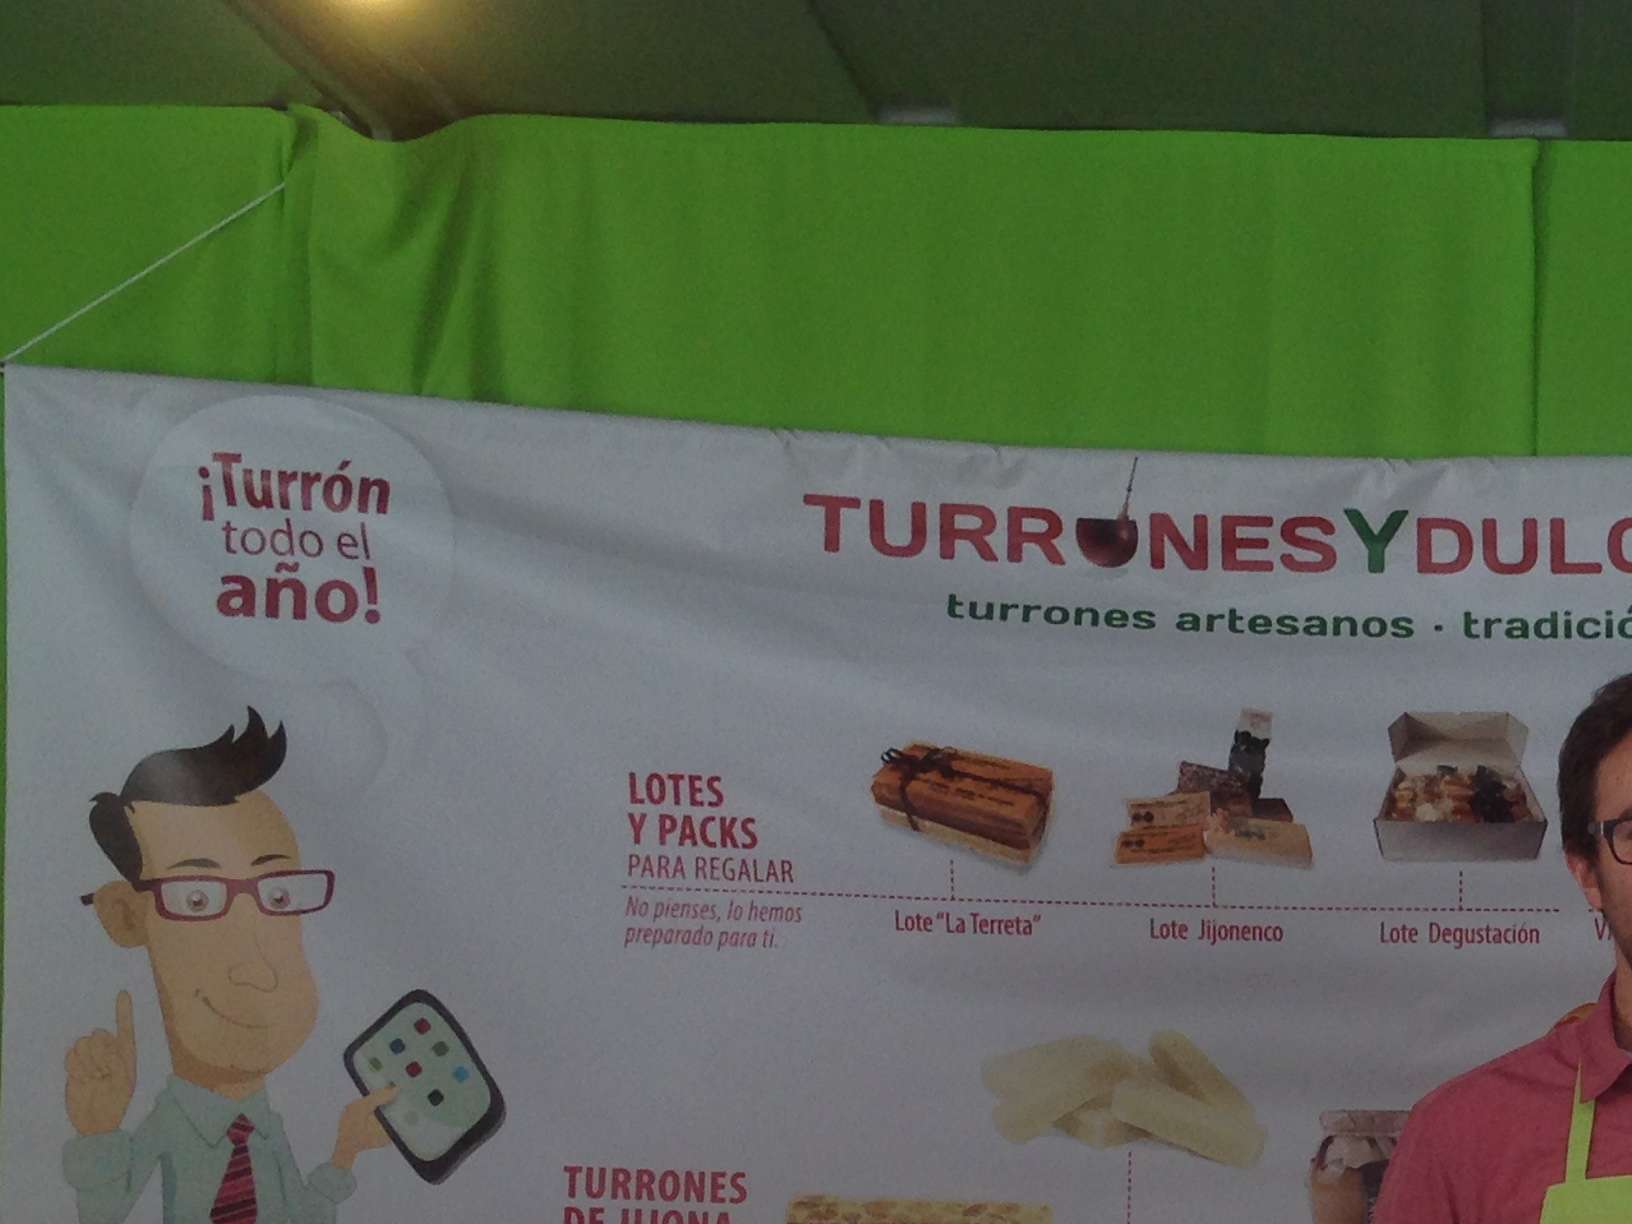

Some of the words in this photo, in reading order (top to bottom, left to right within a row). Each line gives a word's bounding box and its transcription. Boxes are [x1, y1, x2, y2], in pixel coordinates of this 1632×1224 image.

[198, 452, 391, 521] ¡Turrón
[222, 520, 323, 560] todo
[336, 522, 371, 560] el
[215, 562, 381, 625] año!
[947, 594, 1156, 630] turrones
[1175, 606, 1415, 638] artesanos
[628, 772, 724, 807] LOTES
[627, 812, 647, 845] Y
[658, 814, 758, 850] PACKS
[628, 854, 686, 880] PARA
[695, 857, 794, 883] REGALAR
[625, 897, 649, 917] No
[653, 900, 721, 924] pienses,
[727, 901, 743, 921] lo
[749, 901, 803, 923] hemos
[895, 910, 933, 933] Lote
[624, 925, 713, 949] preparado
[717, 930, 757, 951] para
[1150, 918, 1188, 942] Lote
[1197, 918, 1283, 943] Jijonenco
[1380, 921, 1418, 944] Lote
[1429, 921, 1540, 949] Degustación
[563, 1164, 748, 1205] TURRONES
